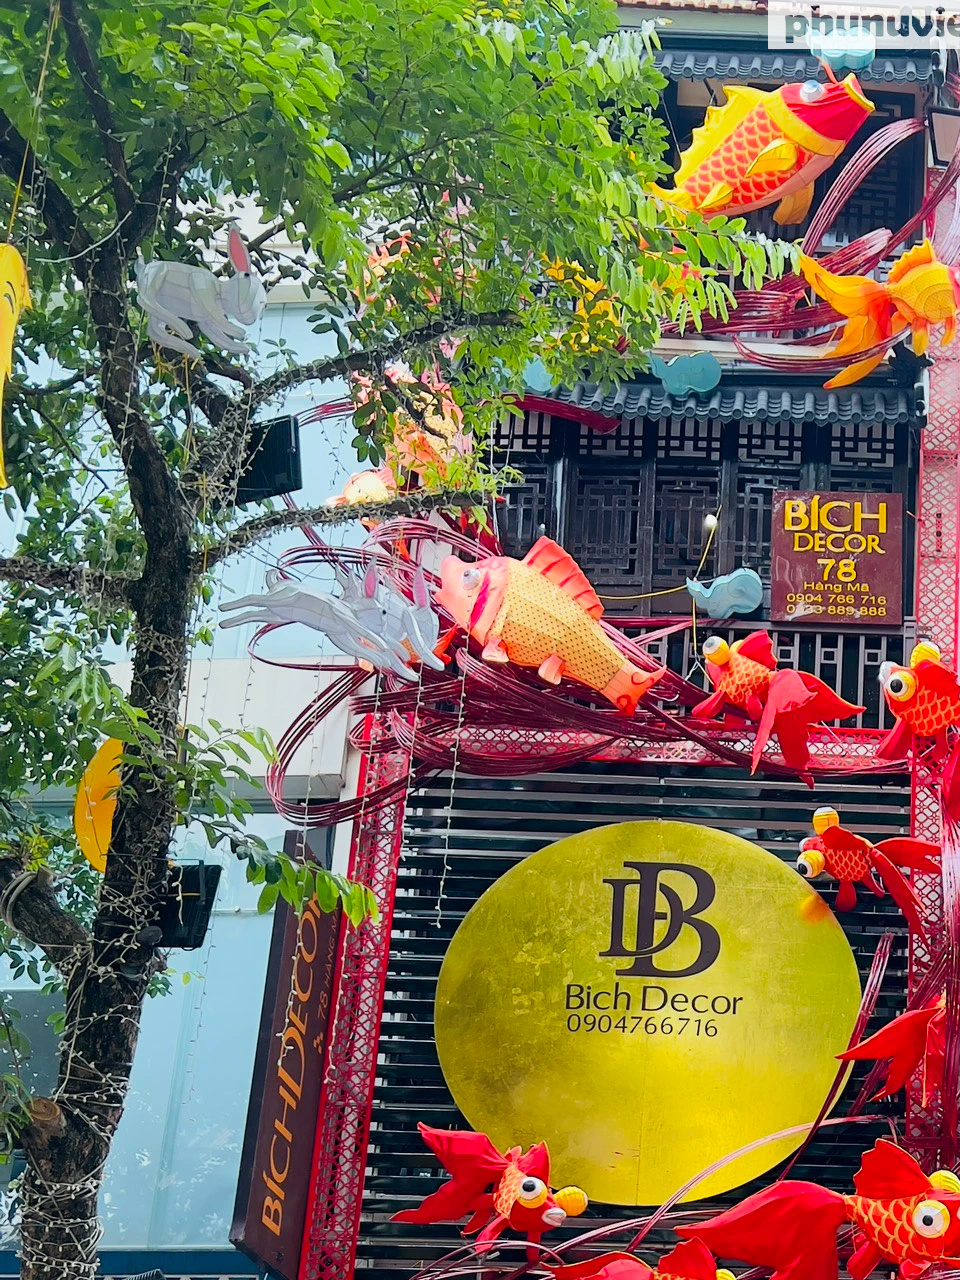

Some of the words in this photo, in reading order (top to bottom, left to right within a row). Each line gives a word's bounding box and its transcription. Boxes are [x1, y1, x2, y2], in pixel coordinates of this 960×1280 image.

[784, 495, 887, 533] BÍCH
[793, 532, 886, 555] DECOR
[816, 558, 857, 582] 78
[786, 593, 823, 603] 0904
[827, 594, 855, 604] 766
[861, 595, 887, 605] 716
[804, 581, 842, 594] Hàng
[786, 605, 823, 614] 033
[861, 606, 887, 616] 888
[317, 990, 329, 1020] 78
[565, 982, 631, 1011] Bich
[641, 985, 744, 1015] Decor
[567, 1013, 718, 1038] 0904766716
[261, 1084, 297, 1236] BÍCH
